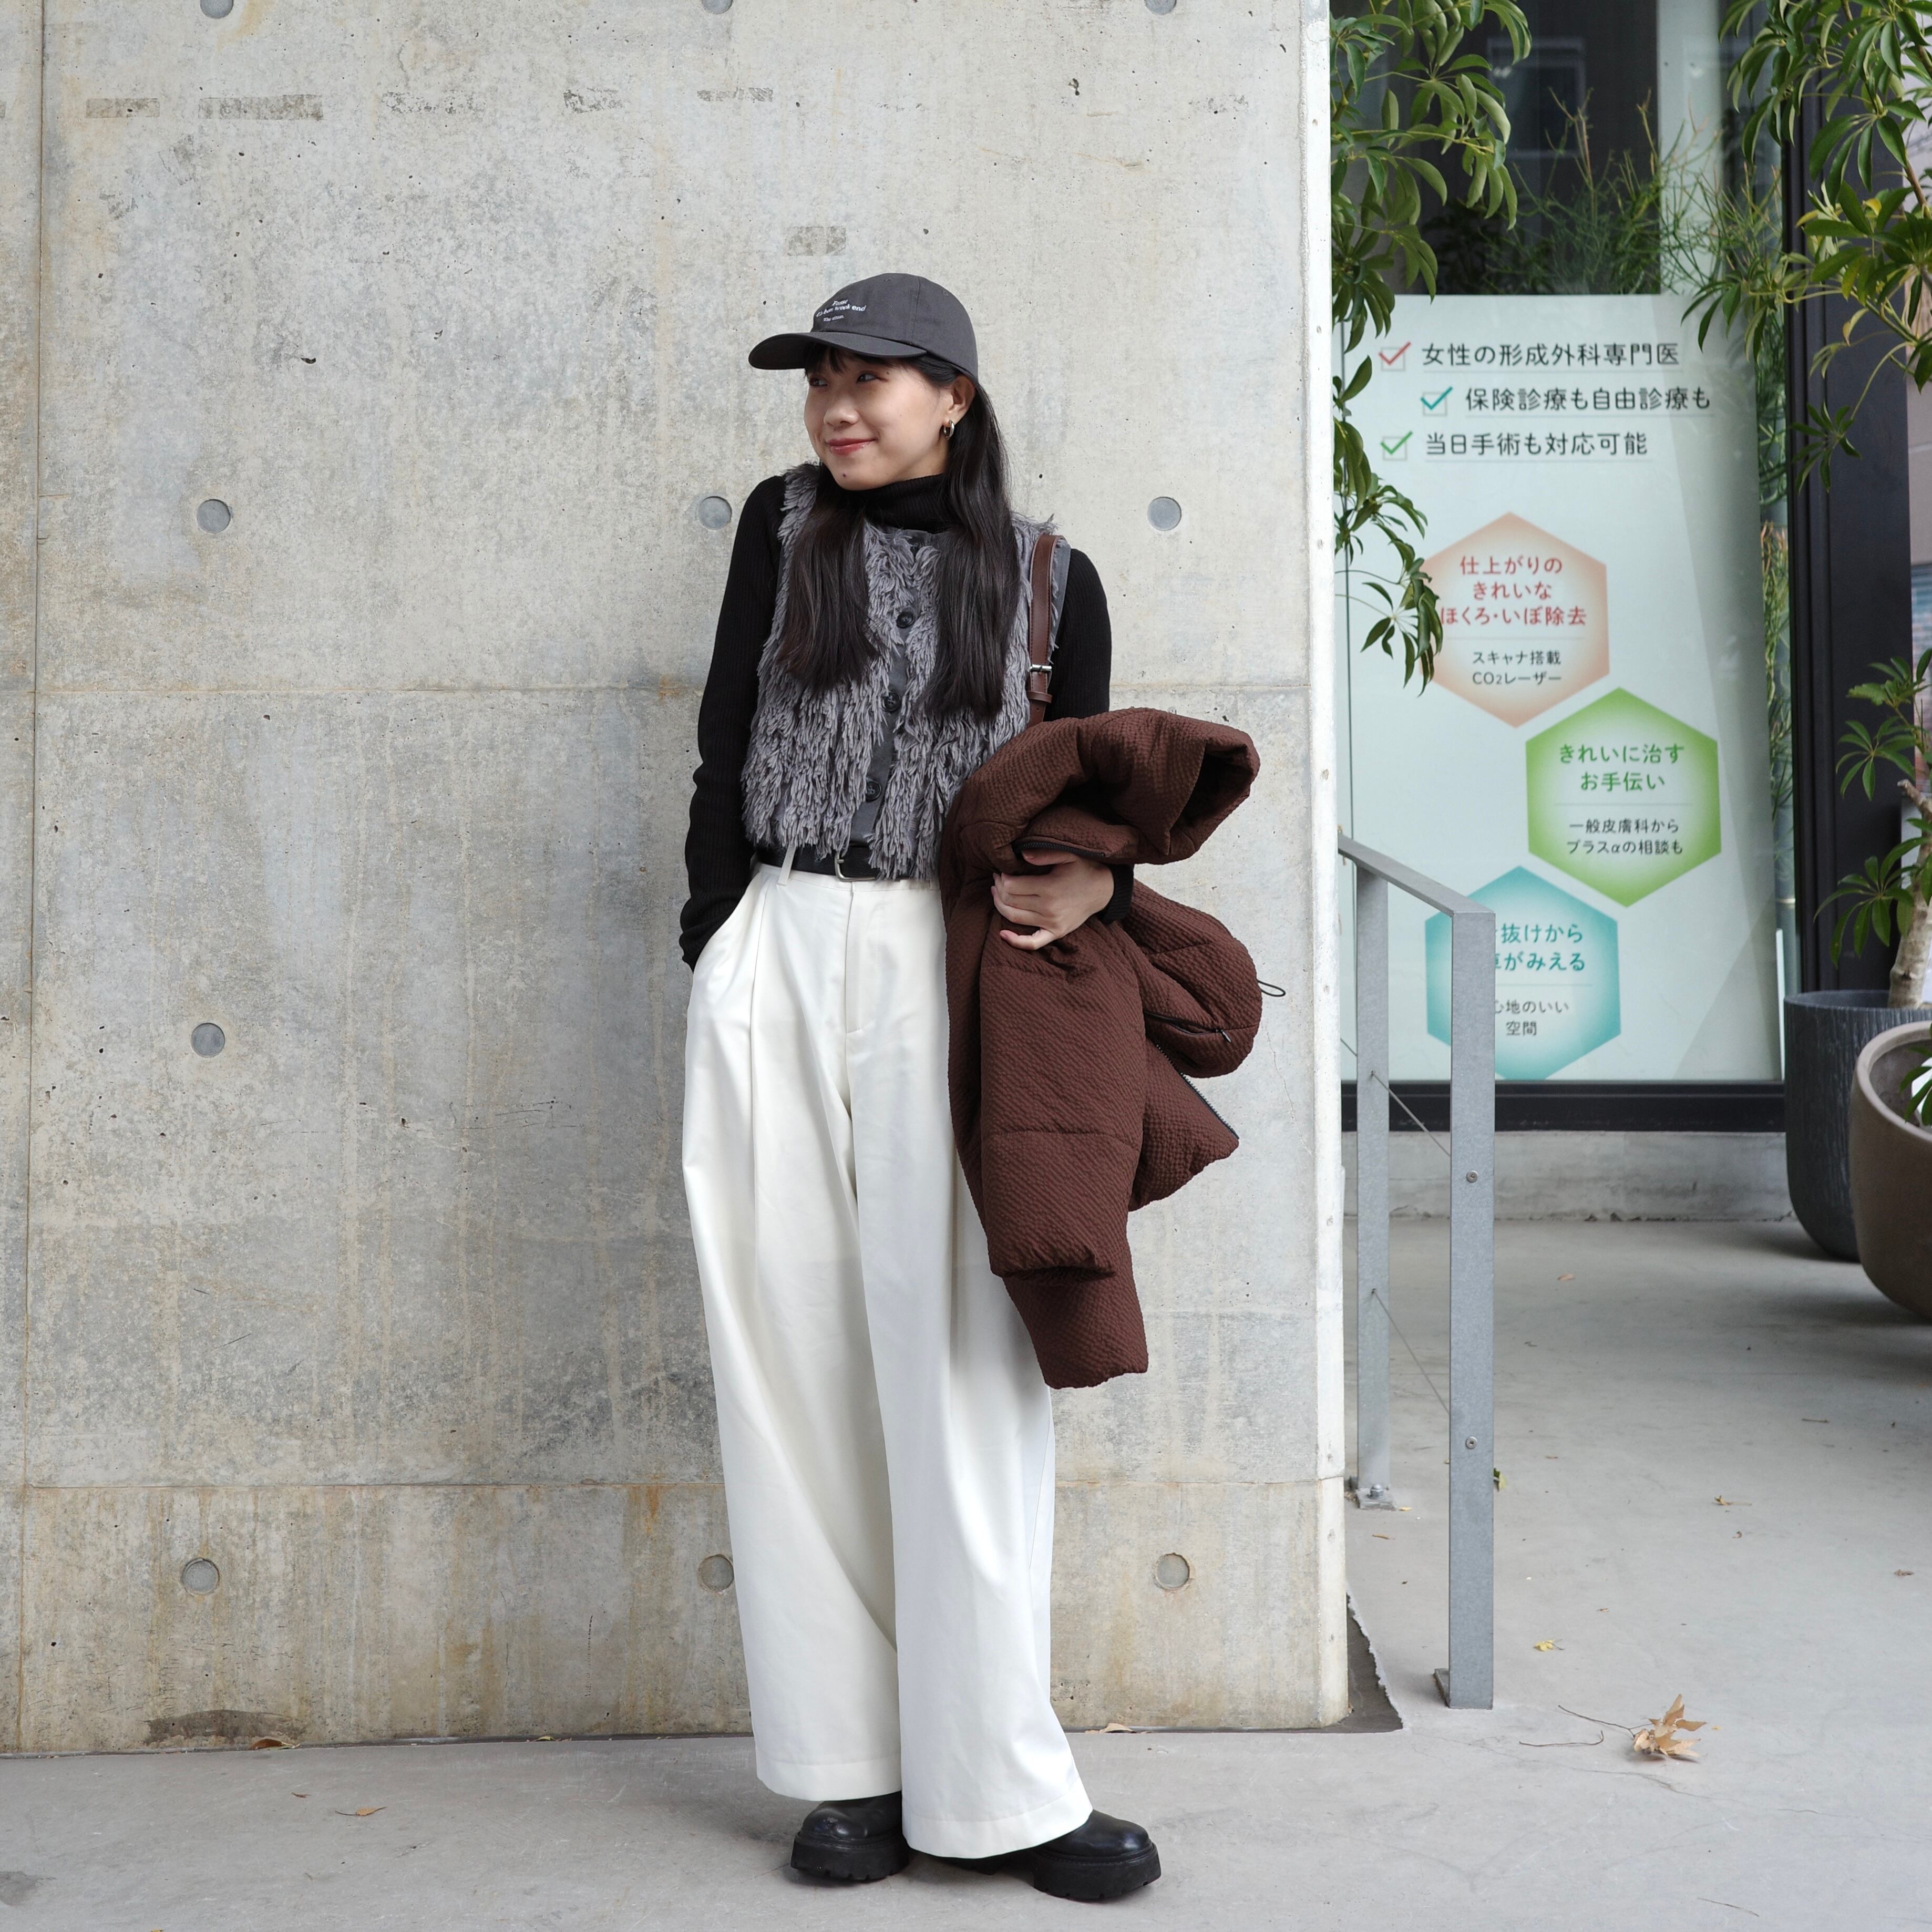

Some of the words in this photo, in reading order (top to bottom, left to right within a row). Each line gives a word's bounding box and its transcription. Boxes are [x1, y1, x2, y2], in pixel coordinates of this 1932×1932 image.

[1422, 343, 1679, 366] 女性の形成外科専門医
[1465, 387, 1711, 411] 保険診療も自由診療も
[1425, 431, 1648, 456] 当日手術も対応可能
[1460, 555, 1563, 576] 仕上がりの
[1473, 581, 1552, 600] きれいな
[1441, 606, 1587, 626] ほくろ・いぼ除去
[1472, 650, 1561, 665] スキャナ搭載
[1559, 743, 1685, 764] きれいに治す
[1580, 771, 1666, 792] お手伝い
[1569, 818, 1679, 834] 一般皮膚科から
[1567, 840, 1683, 855] プラスαの相談も
[1495, 923, 1583, 943] 抜けから
[1506, 1020, 1537, 1036] 空間
